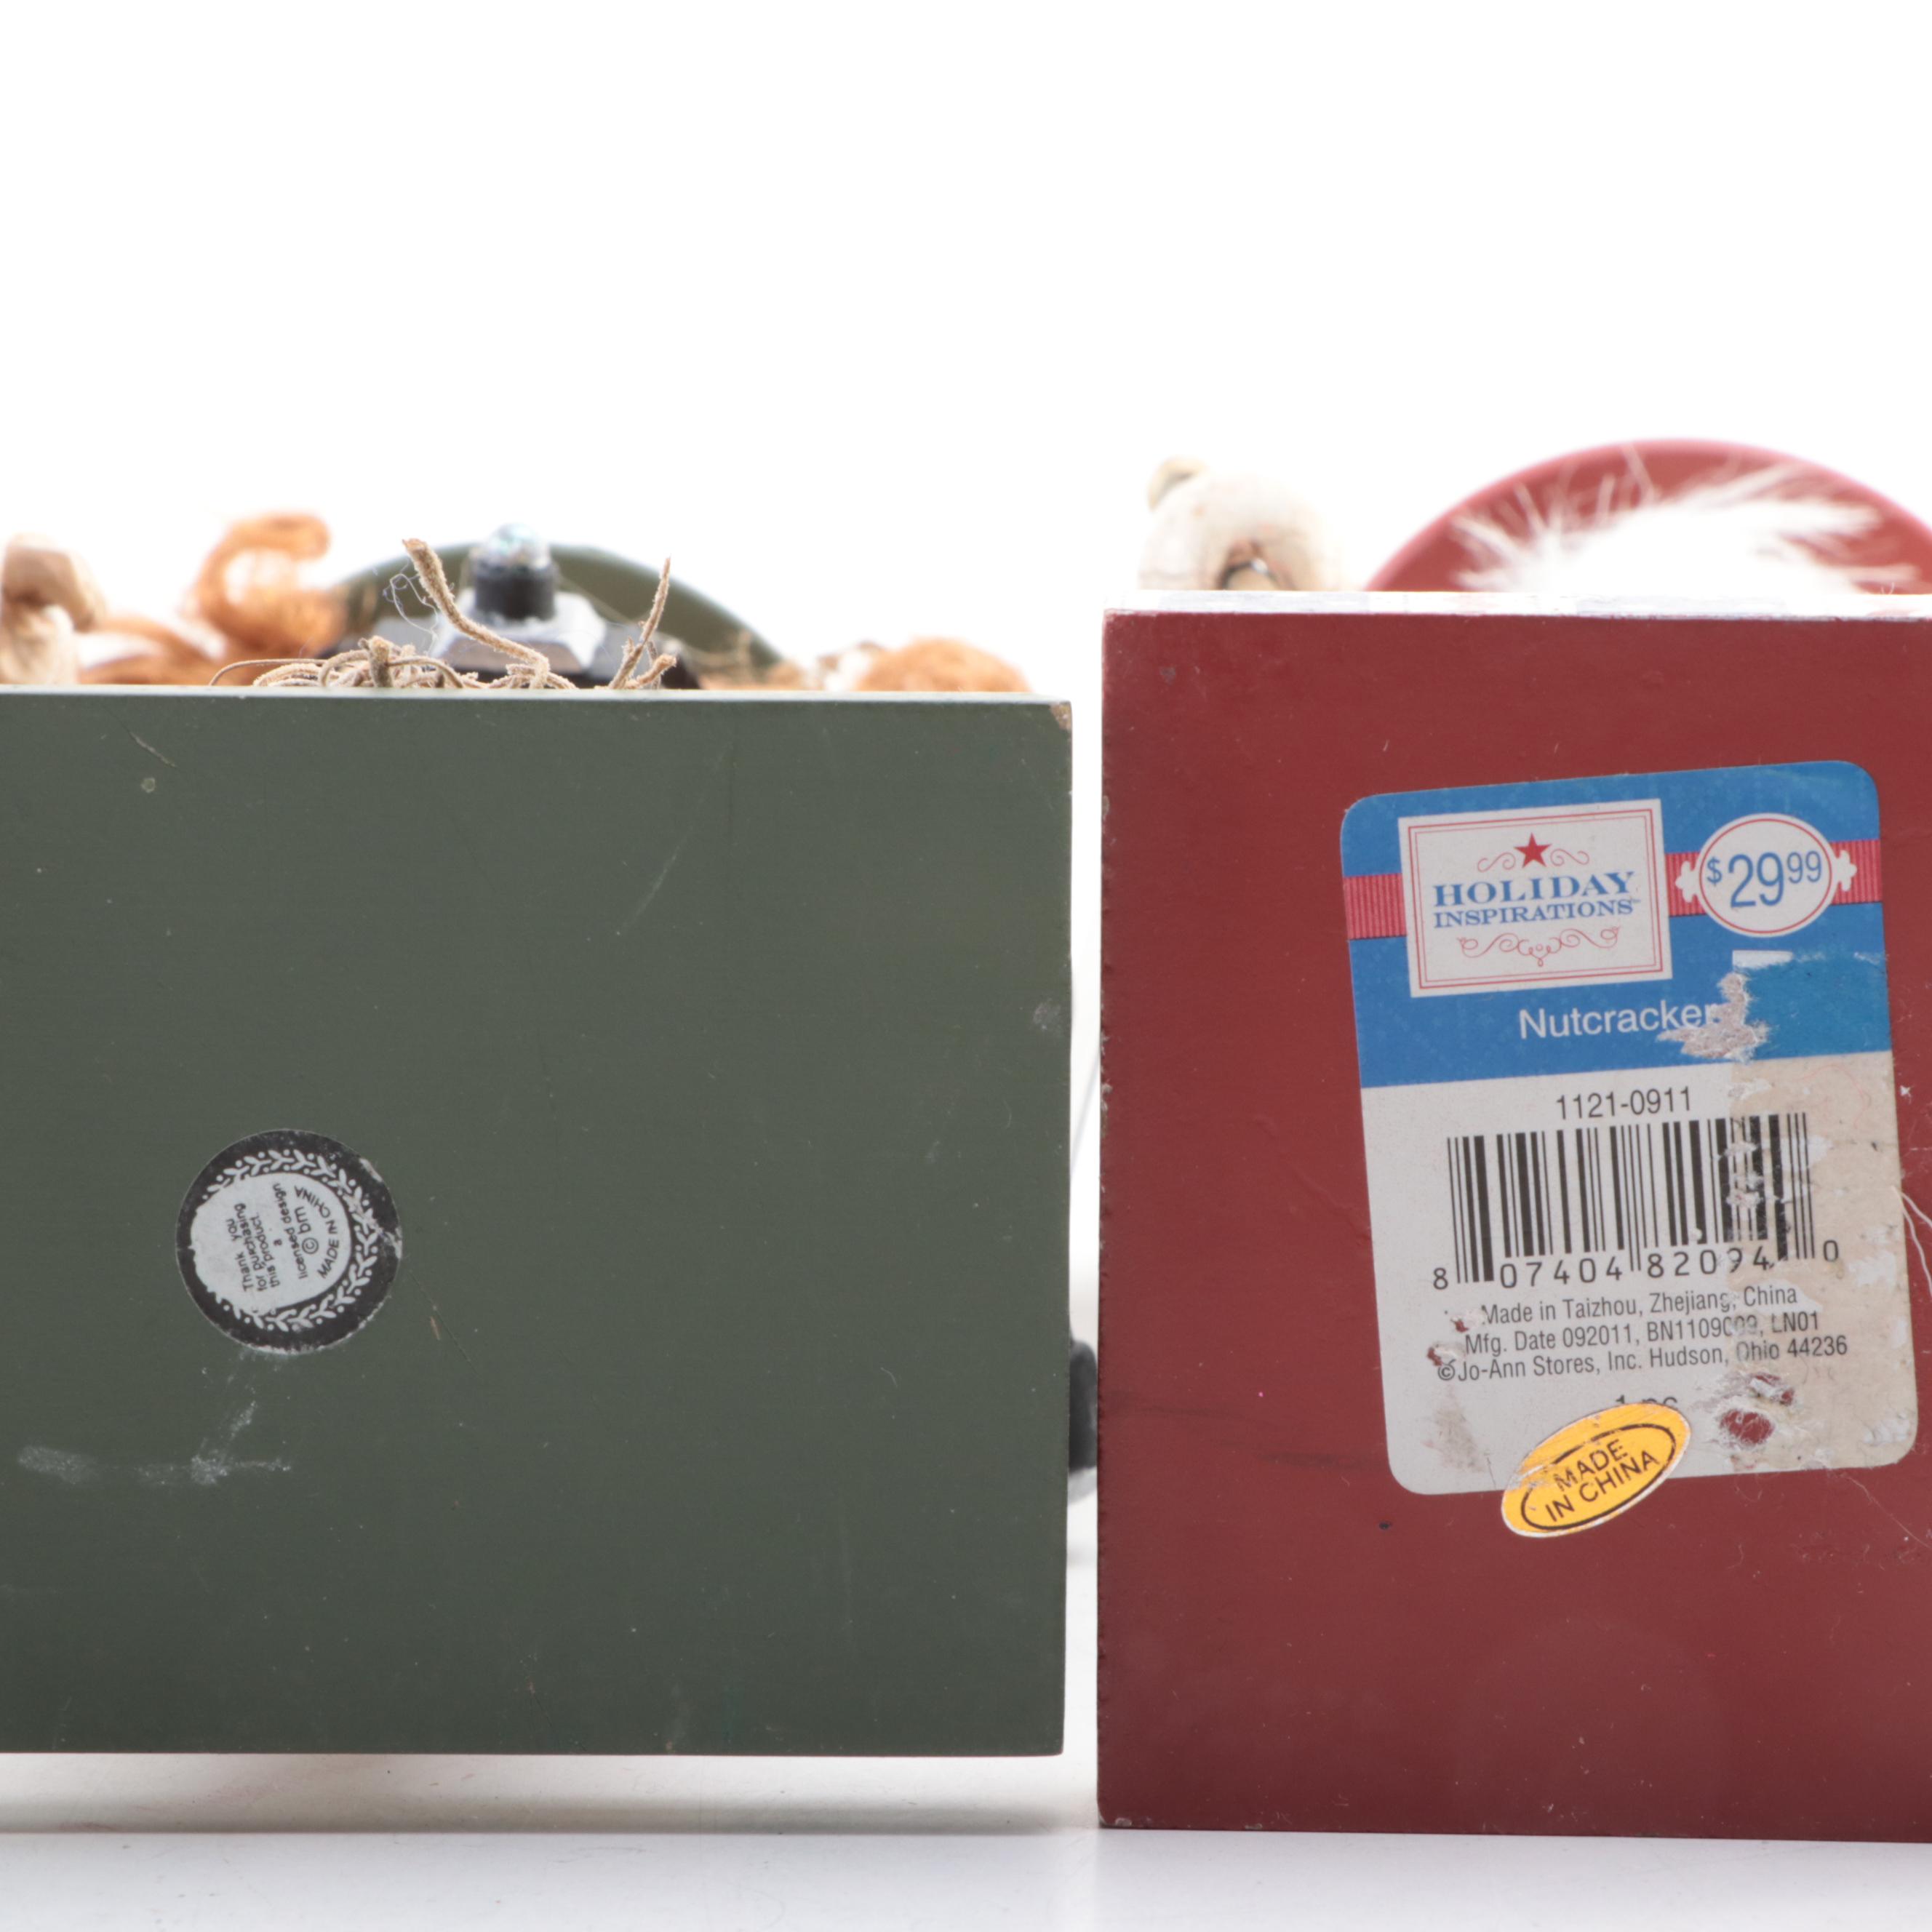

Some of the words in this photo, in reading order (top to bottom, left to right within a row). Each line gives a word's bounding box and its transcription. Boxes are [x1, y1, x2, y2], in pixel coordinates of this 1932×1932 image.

[1433, 871, 1634, 907] HOLIDAY
[1434, 898, 1634, 928] INSPIRATIONS
[1556, 1085, 1691, 1120] 1121-0911
[272, 1183, 292, 1224] design
[294, 1185, 331, 1218] CHINA
[225, 1218, 242, 1242] you
[326, 1220, 338, 1234] IN
[235, 1251, 253, 1292] Thank
[284, 1227, 308, 1280] licensed
[316, 1239, 340, 1279] MADE
[1433, 1267, 1449, 1290] 8
[1822, 1240, 1840, 1263] 0
[255, 1275, 268, 1292] for
[267, 1266, 280, 1288] this
[1481, 1302, 1533, 1325] Made
[1539, 1301, 1557, 1321] in
[1563, 1297, 1643, 1320] Taizhou,
[1743, 1285, 1797, 1307] China
[1464, 1333, 1508, 1357] Mfg.
[1514, 1330, 1557, 1352] Date
[1563, 1323, 1640, 1348] 092011,
[1533, 1354, 1601, 1376] Stores,
[1608, 1351, 1642, 1371] Inc.
[1649, 1346, 1730, 1368] Hudson,
[1736, 1339, 1780, 1363] Ohio
[1787, 1335, 1848, 1358] 44236
[1553, 1438, 1629, 1492] MADE
[1545, 1493, 1576, 1522] IN
[1578, 1450, 1660, 1503] CHINA
